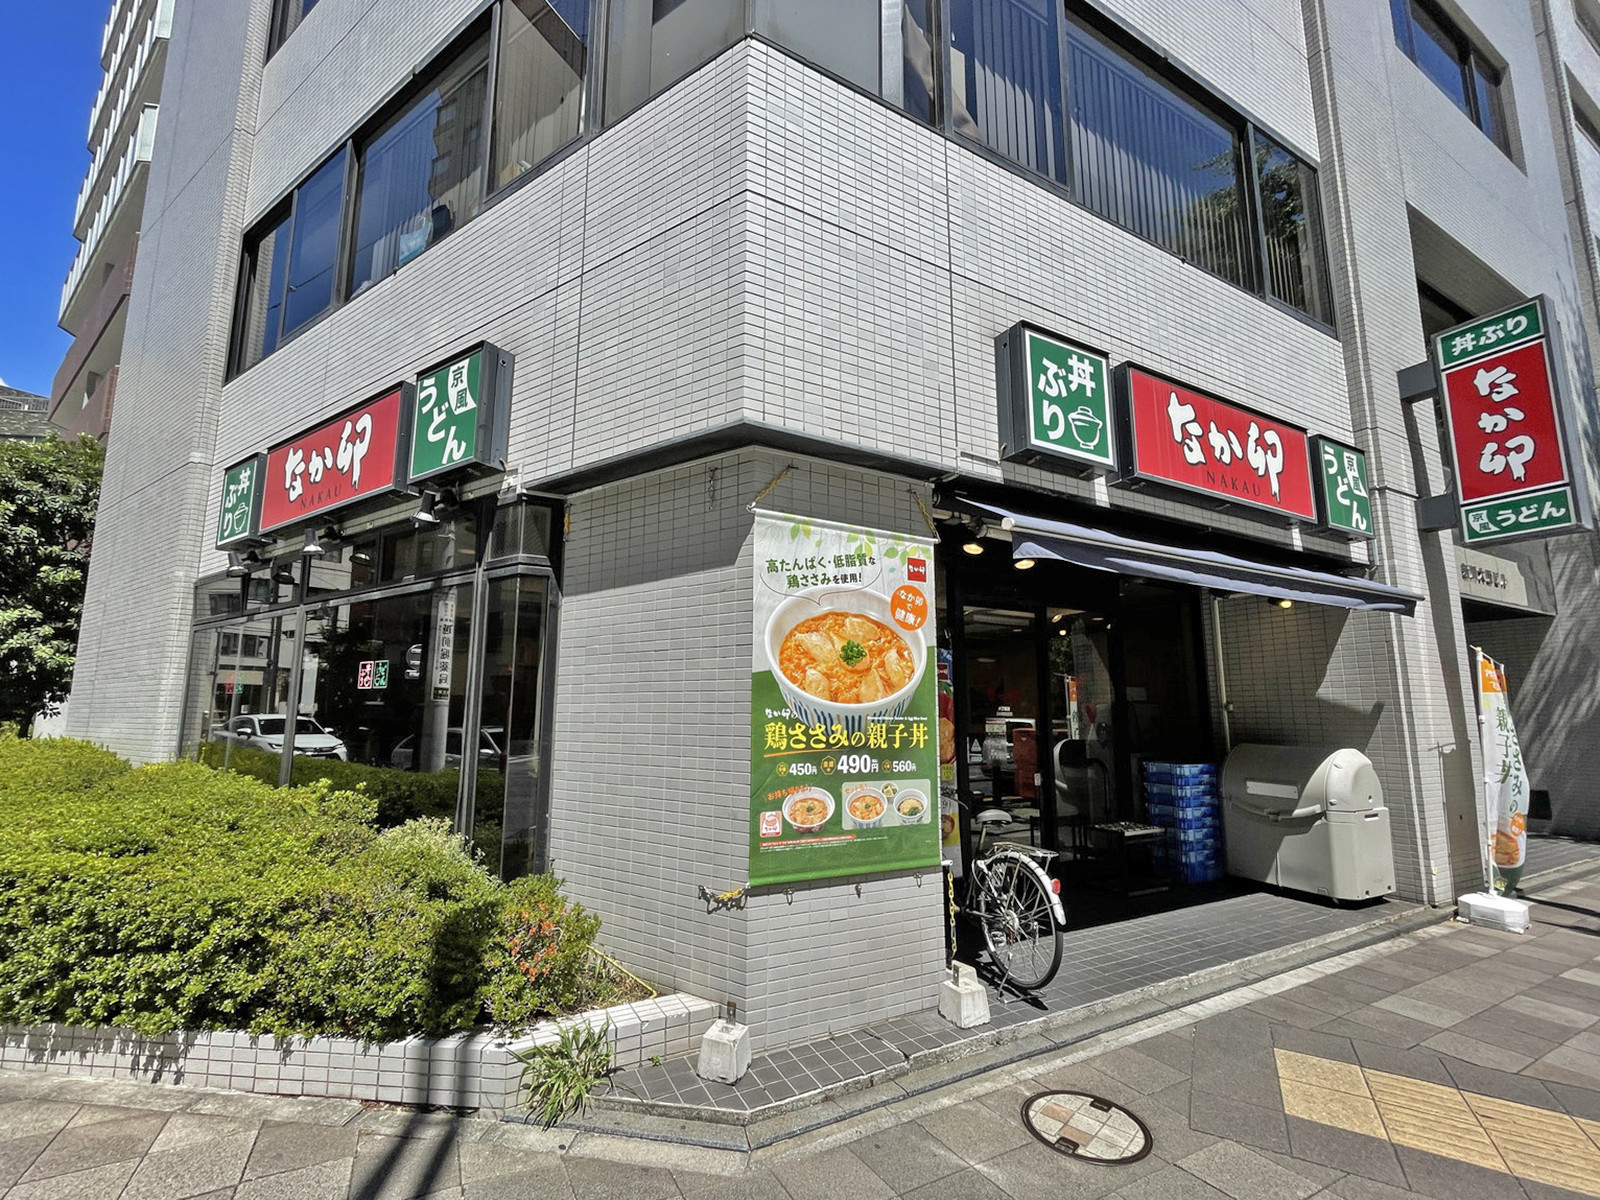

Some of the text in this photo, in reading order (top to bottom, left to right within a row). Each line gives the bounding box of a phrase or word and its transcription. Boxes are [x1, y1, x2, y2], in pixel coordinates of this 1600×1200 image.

[1451, 315, 1528, 356] 丼ぶり
[451, 366, 469, 410] 京風
[419, 377, 466, 464] うどん
[1473, 365, 1535, 482] なか卯
[284, 413, 372, 502] なか卯
[1167, 391, 1285, 503] なか卯
[300, 484, 343, 509] NAKAU
[1206, 471, 1262, 497] NAKAU
[1323, 446, 1367, 531] うどん
[1496, 501, 1566, 527] うどん
[766, 554, 876, 574] 高たんぱく・低脂質な
[764, 722, 929, 750] 鶏ささみの親子丼
